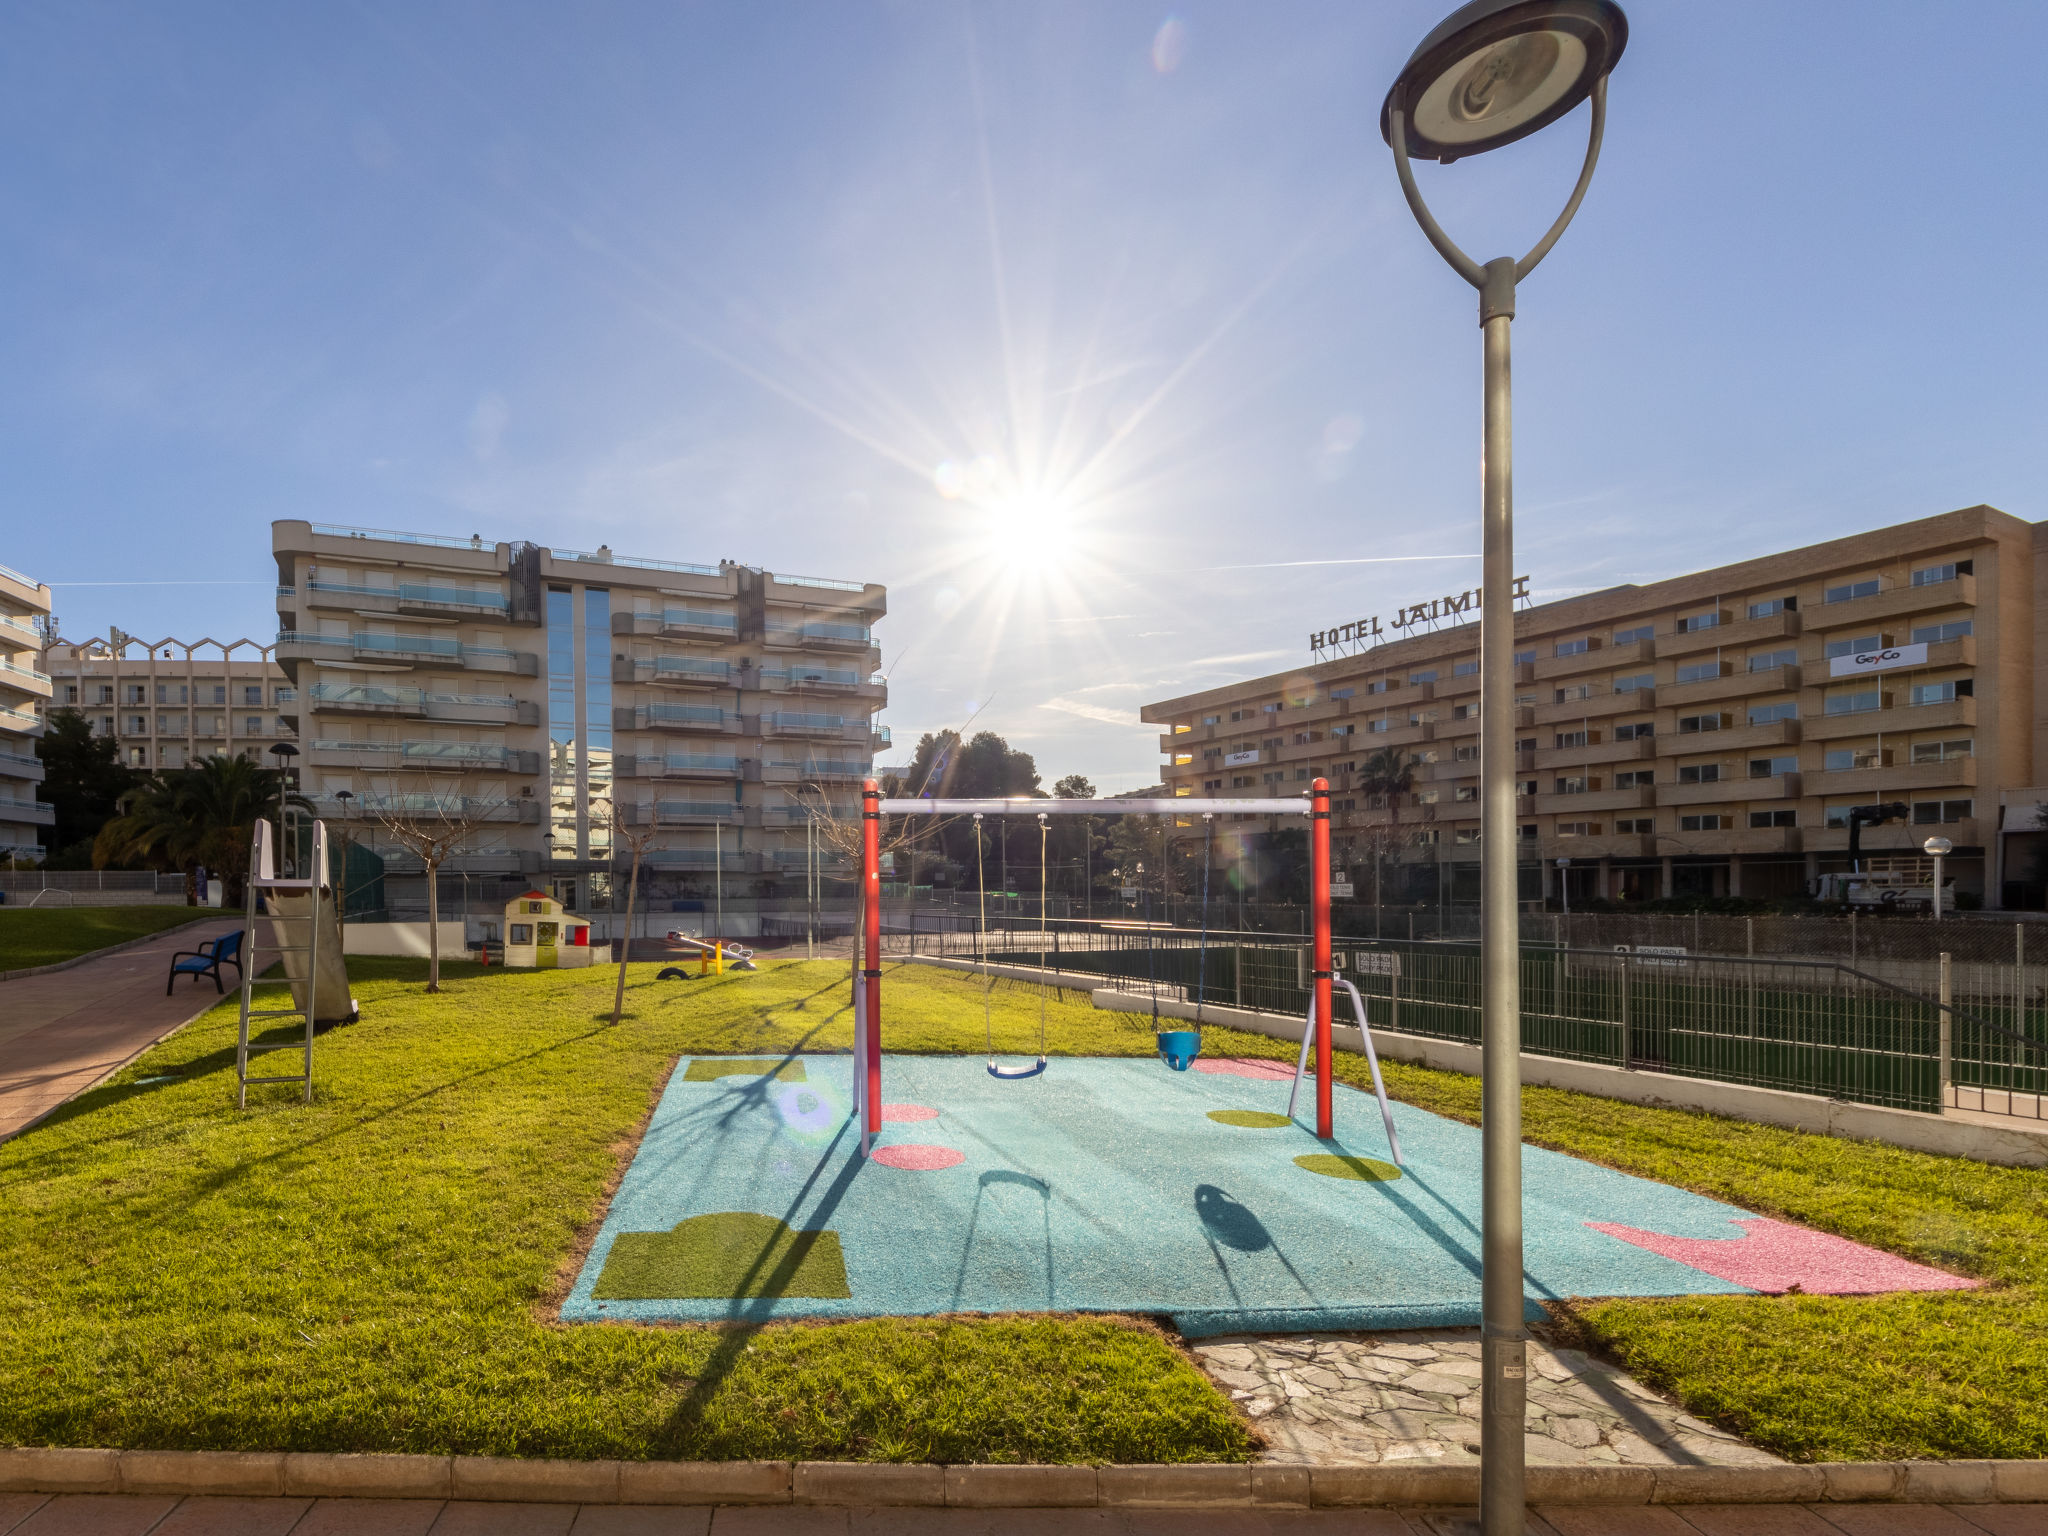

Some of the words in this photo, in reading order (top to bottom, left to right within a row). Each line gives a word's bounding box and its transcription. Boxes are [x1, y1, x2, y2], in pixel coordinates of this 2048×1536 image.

[1310, 616, 1383, 651] HOTEL
[1856, 650, 1900, 664] GeyCo
[1338, 873, 1343, 882] 2
[1334, 954, 1341, 966] 1
